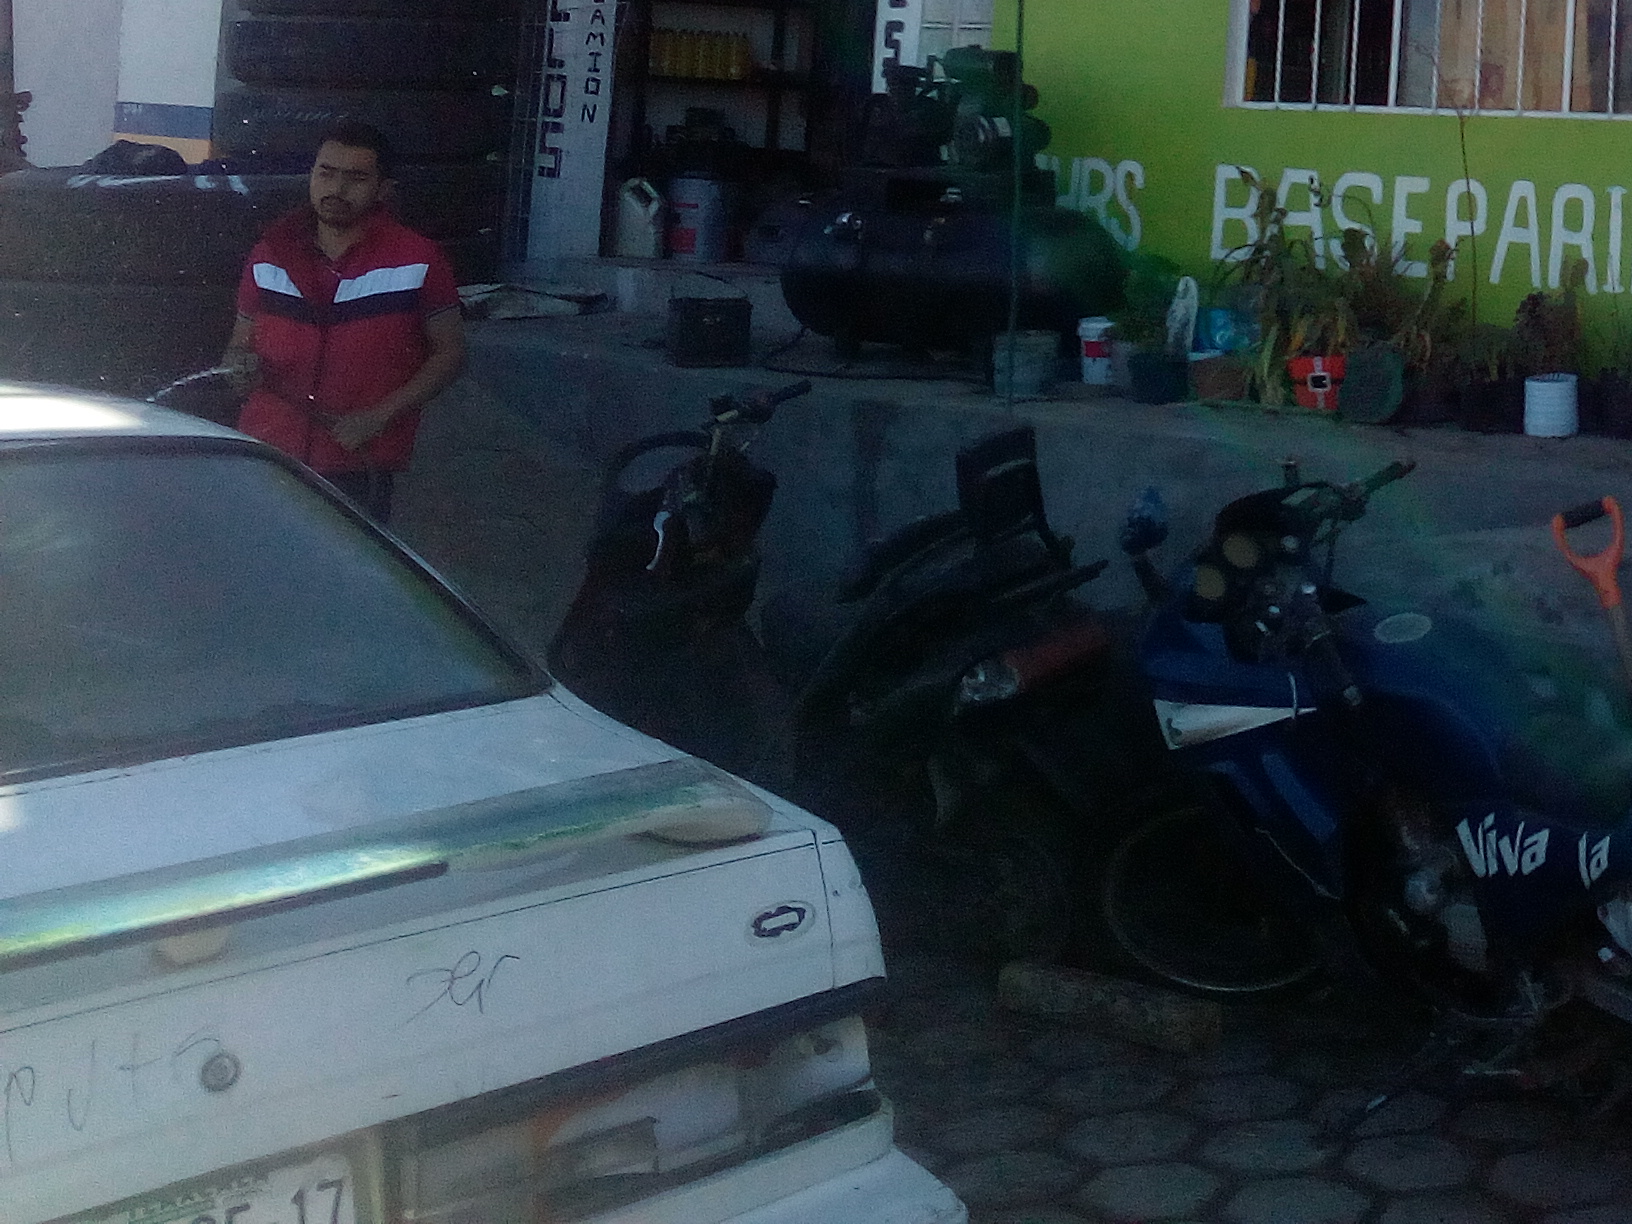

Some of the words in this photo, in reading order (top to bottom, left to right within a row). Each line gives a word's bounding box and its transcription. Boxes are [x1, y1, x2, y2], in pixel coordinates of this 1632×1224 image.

[1210, 164, 1430, 278] BASE
[1455, 812, 1550, 877] Viva
[1578, 831, 1611, 890] la
